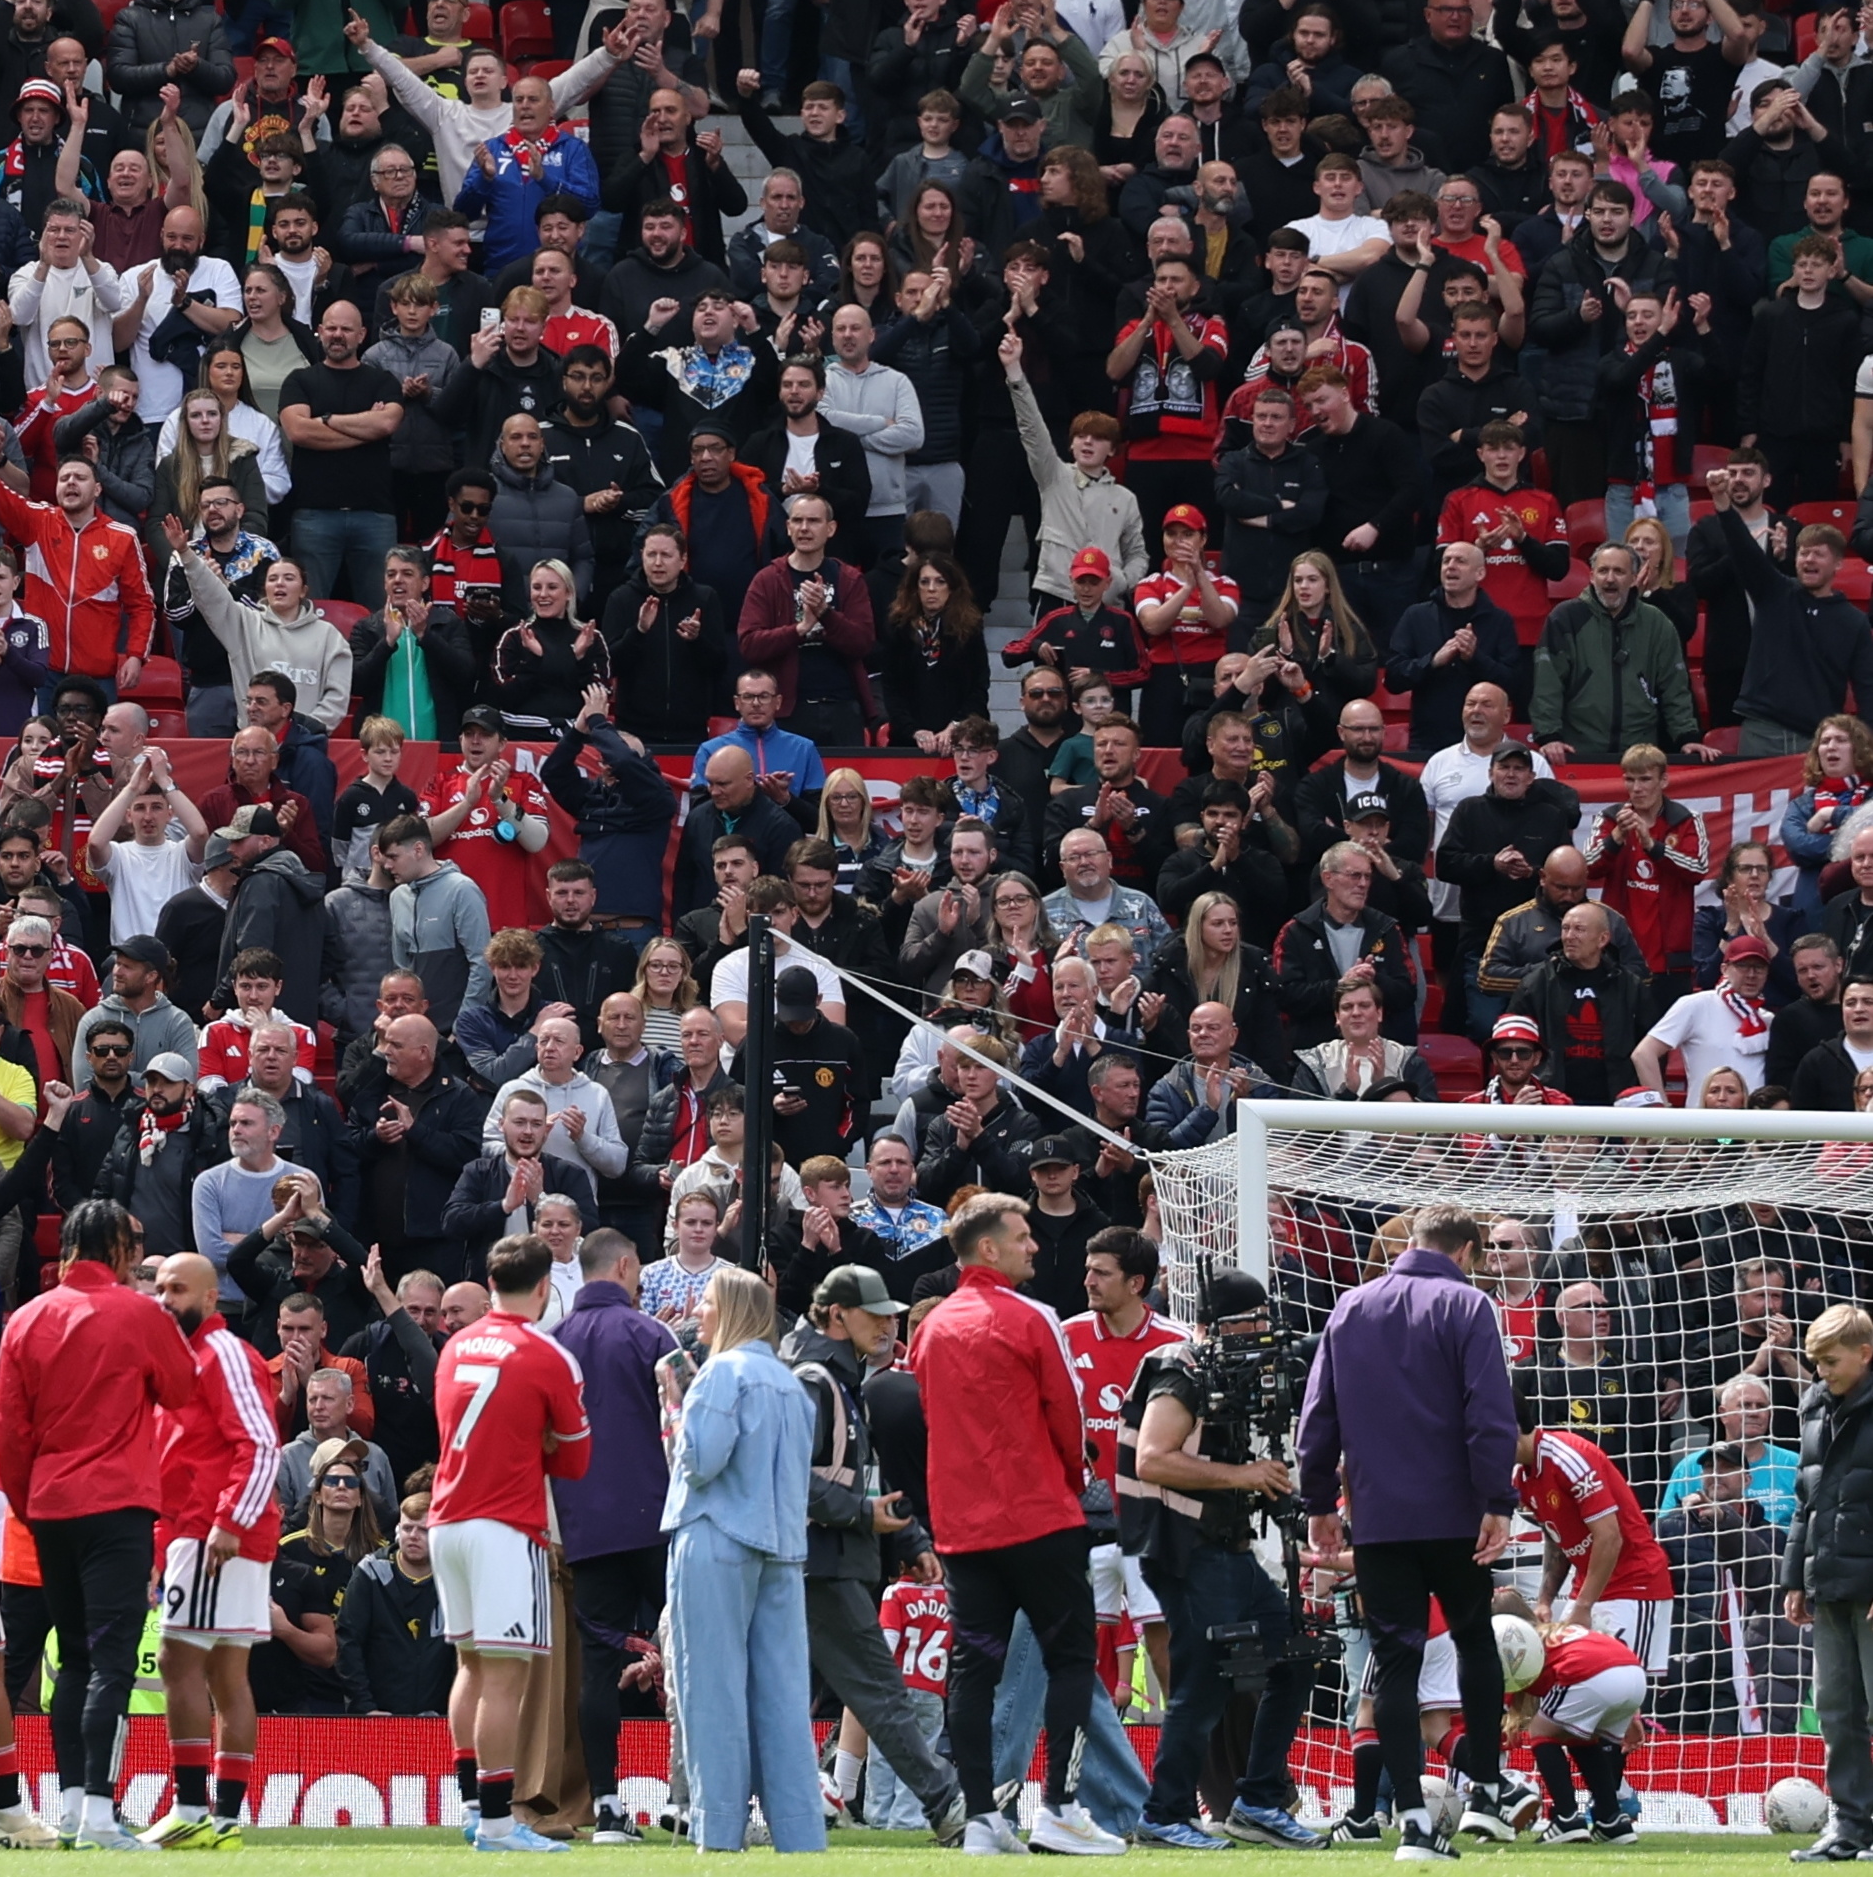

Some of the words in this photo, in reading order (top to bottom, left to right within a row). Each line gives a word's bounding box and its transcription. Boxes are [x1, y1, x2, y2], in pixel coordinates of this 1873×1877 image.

[1357, 795, 1387, 810] ICON
[449, 827, 494, 841] Snapdra
[453, 1333, 515, 1360] MOUNT
[451, 1363, 501, 1451] 7
[167, 1587, 185, 1618] 9
[903, 1625, 948, 1682] 16
